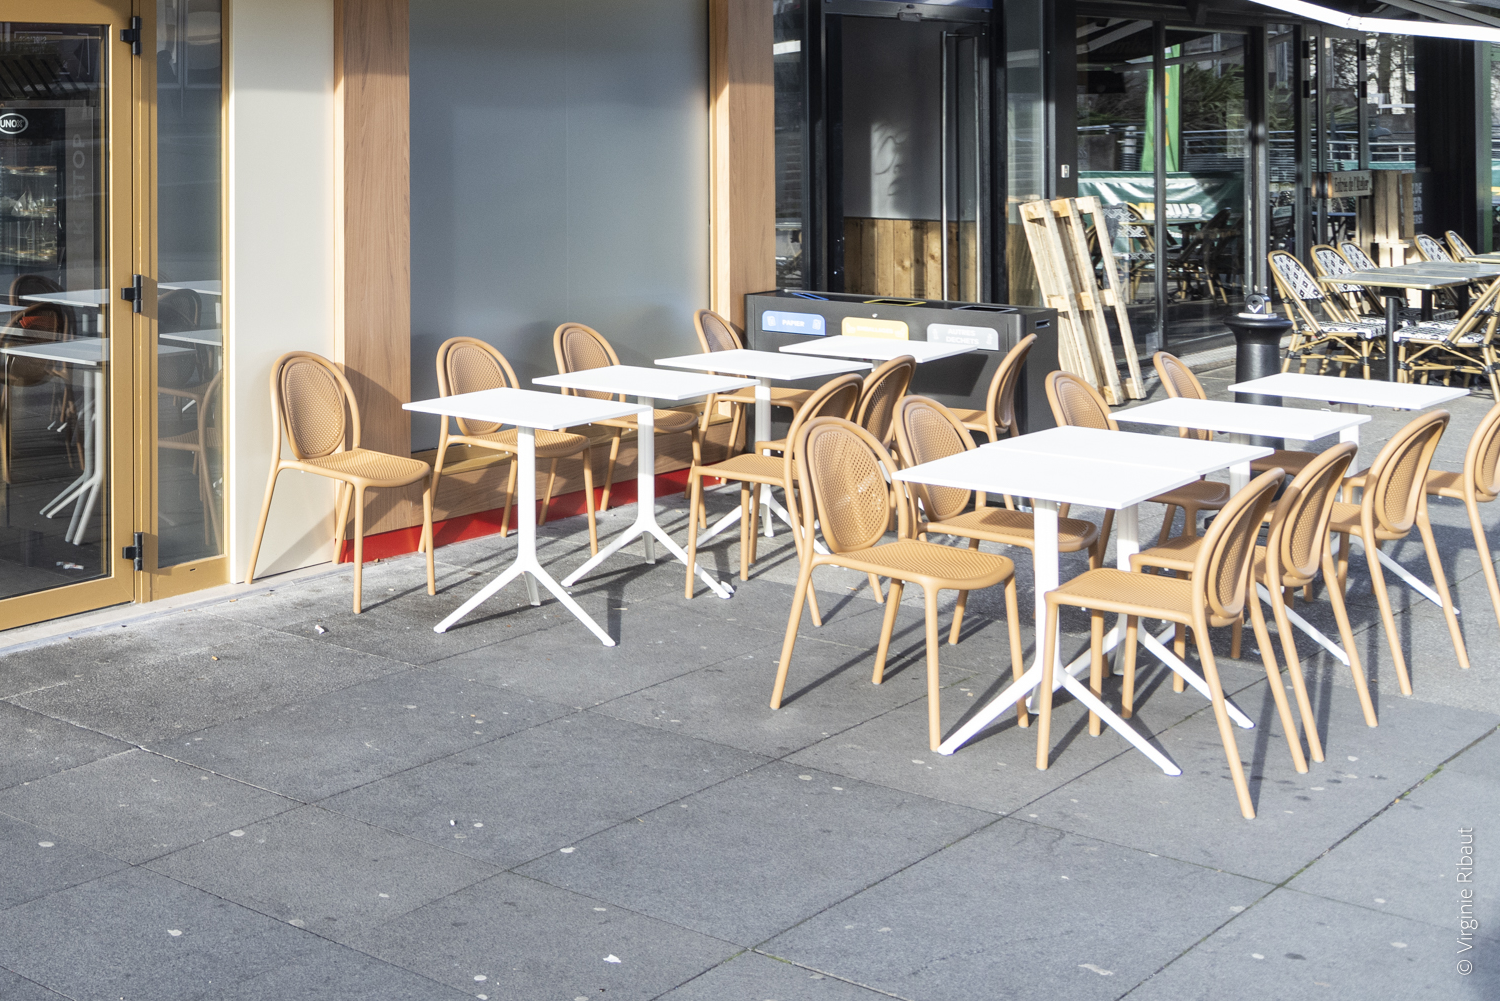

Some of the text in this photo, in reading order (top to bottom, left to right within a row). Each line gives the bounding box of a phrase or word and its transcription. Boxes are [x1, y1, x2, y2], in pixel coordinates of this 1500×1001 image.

[0, 119, 23, 128] UNOX
[782, 319, 805, 328] PAPIER
[947, 328, 976, 337] AUTRES
